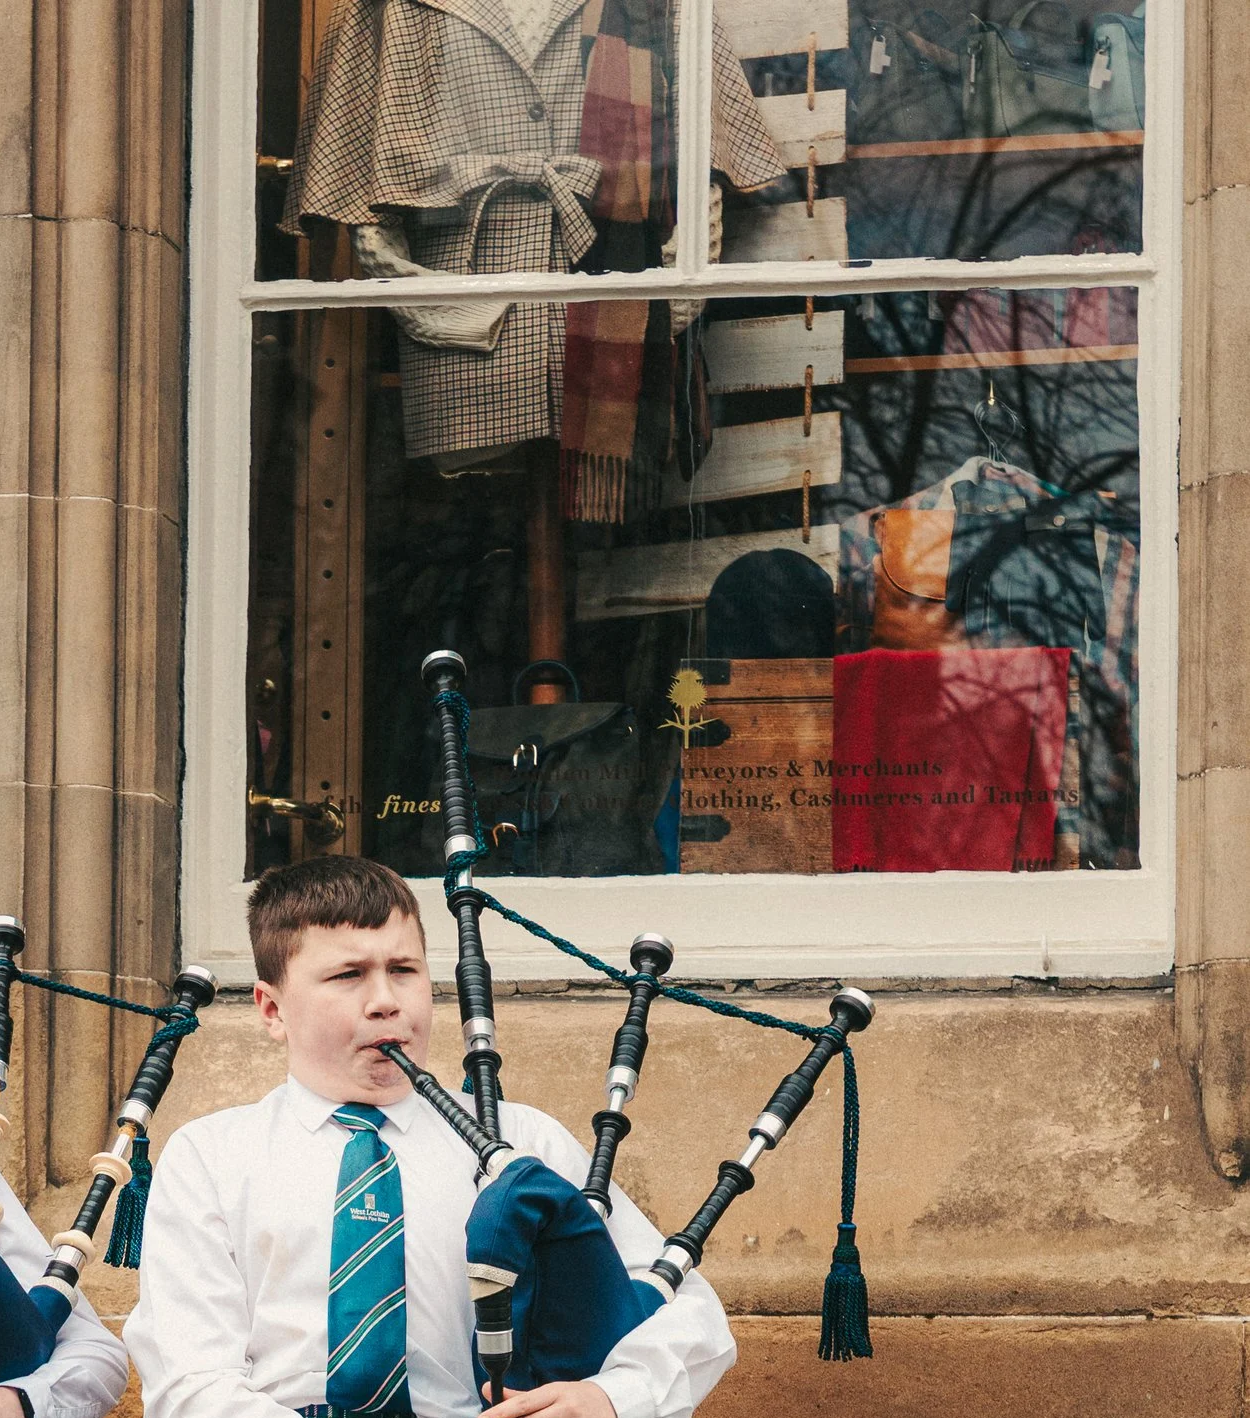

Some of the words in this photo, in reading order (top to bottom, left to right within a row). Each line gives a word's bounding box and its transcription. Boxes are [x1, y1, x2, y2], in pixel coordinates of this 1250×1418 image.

[786, 759, 804, 777] &
[813, 757, 943, 777] Merchants
[377, 794, 442, 819] fines
[789, 786, 923, 808] Cashmeres
[931, 785, 975, 805] and
[983, 784, 1079, 805] Tartans
[350, 1208, 366, 1216] West
[366, 1209, 390, 1219] Lothian
